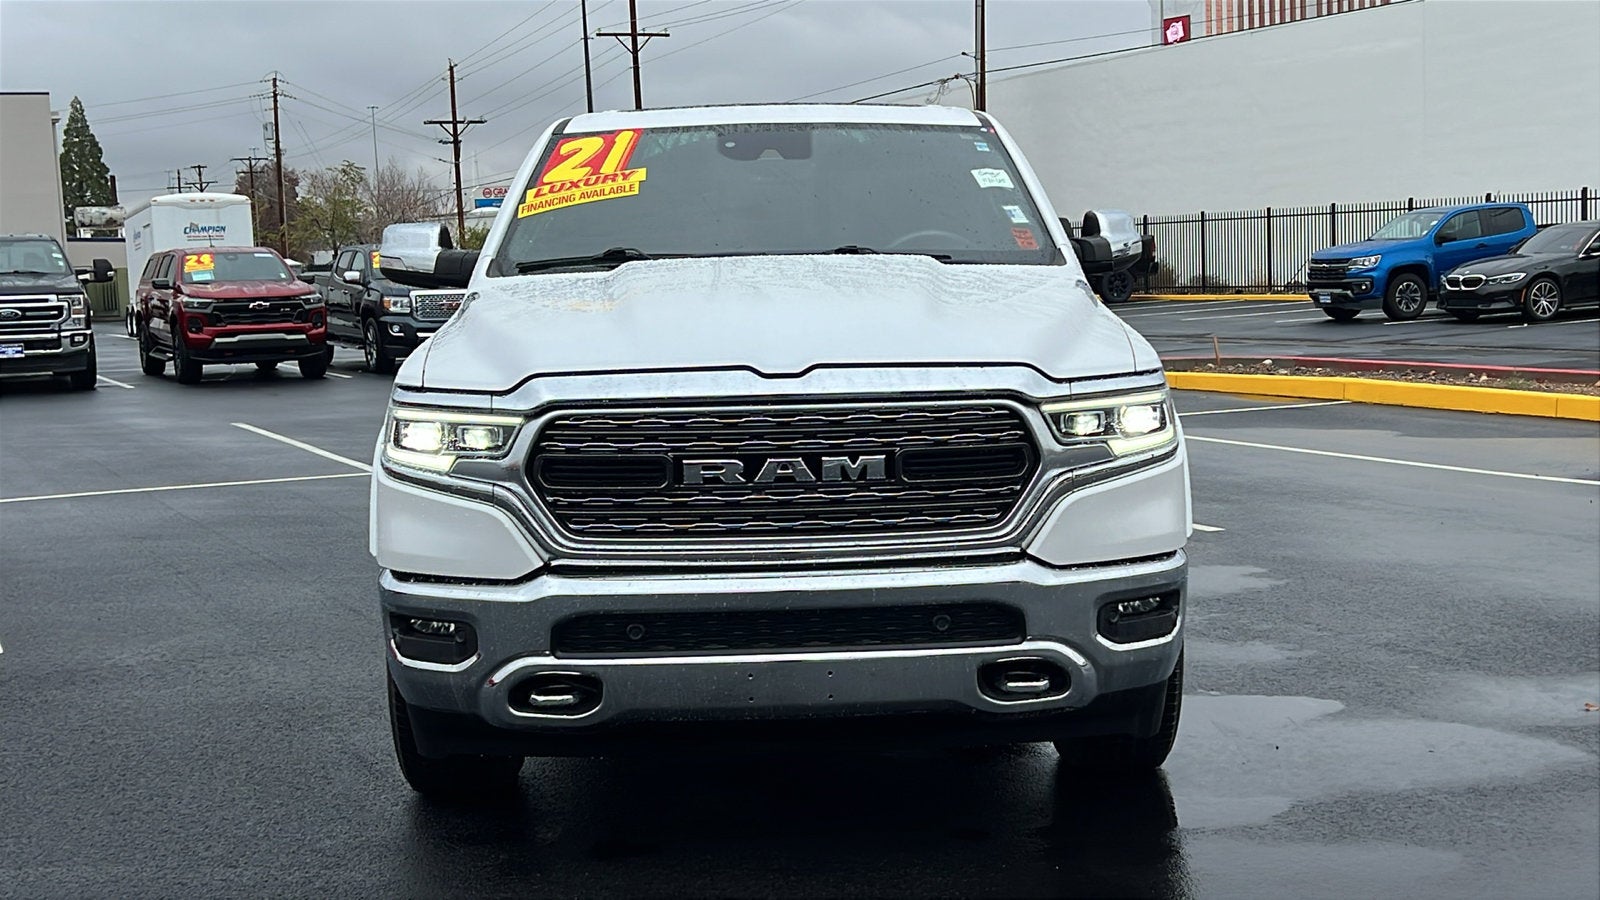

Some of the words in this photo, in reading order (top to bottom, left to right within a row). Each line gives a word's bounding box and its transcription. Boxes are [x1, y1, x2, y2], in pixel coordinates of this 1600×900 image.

[543, 130, 636, 183] 21
[521, 193, 576, 214] FINANCING
[579, 183, 636, 200] AVAILABLE
[533, 170, 639, 199] LUXURY
[682, 455, 887, 484] RAM
